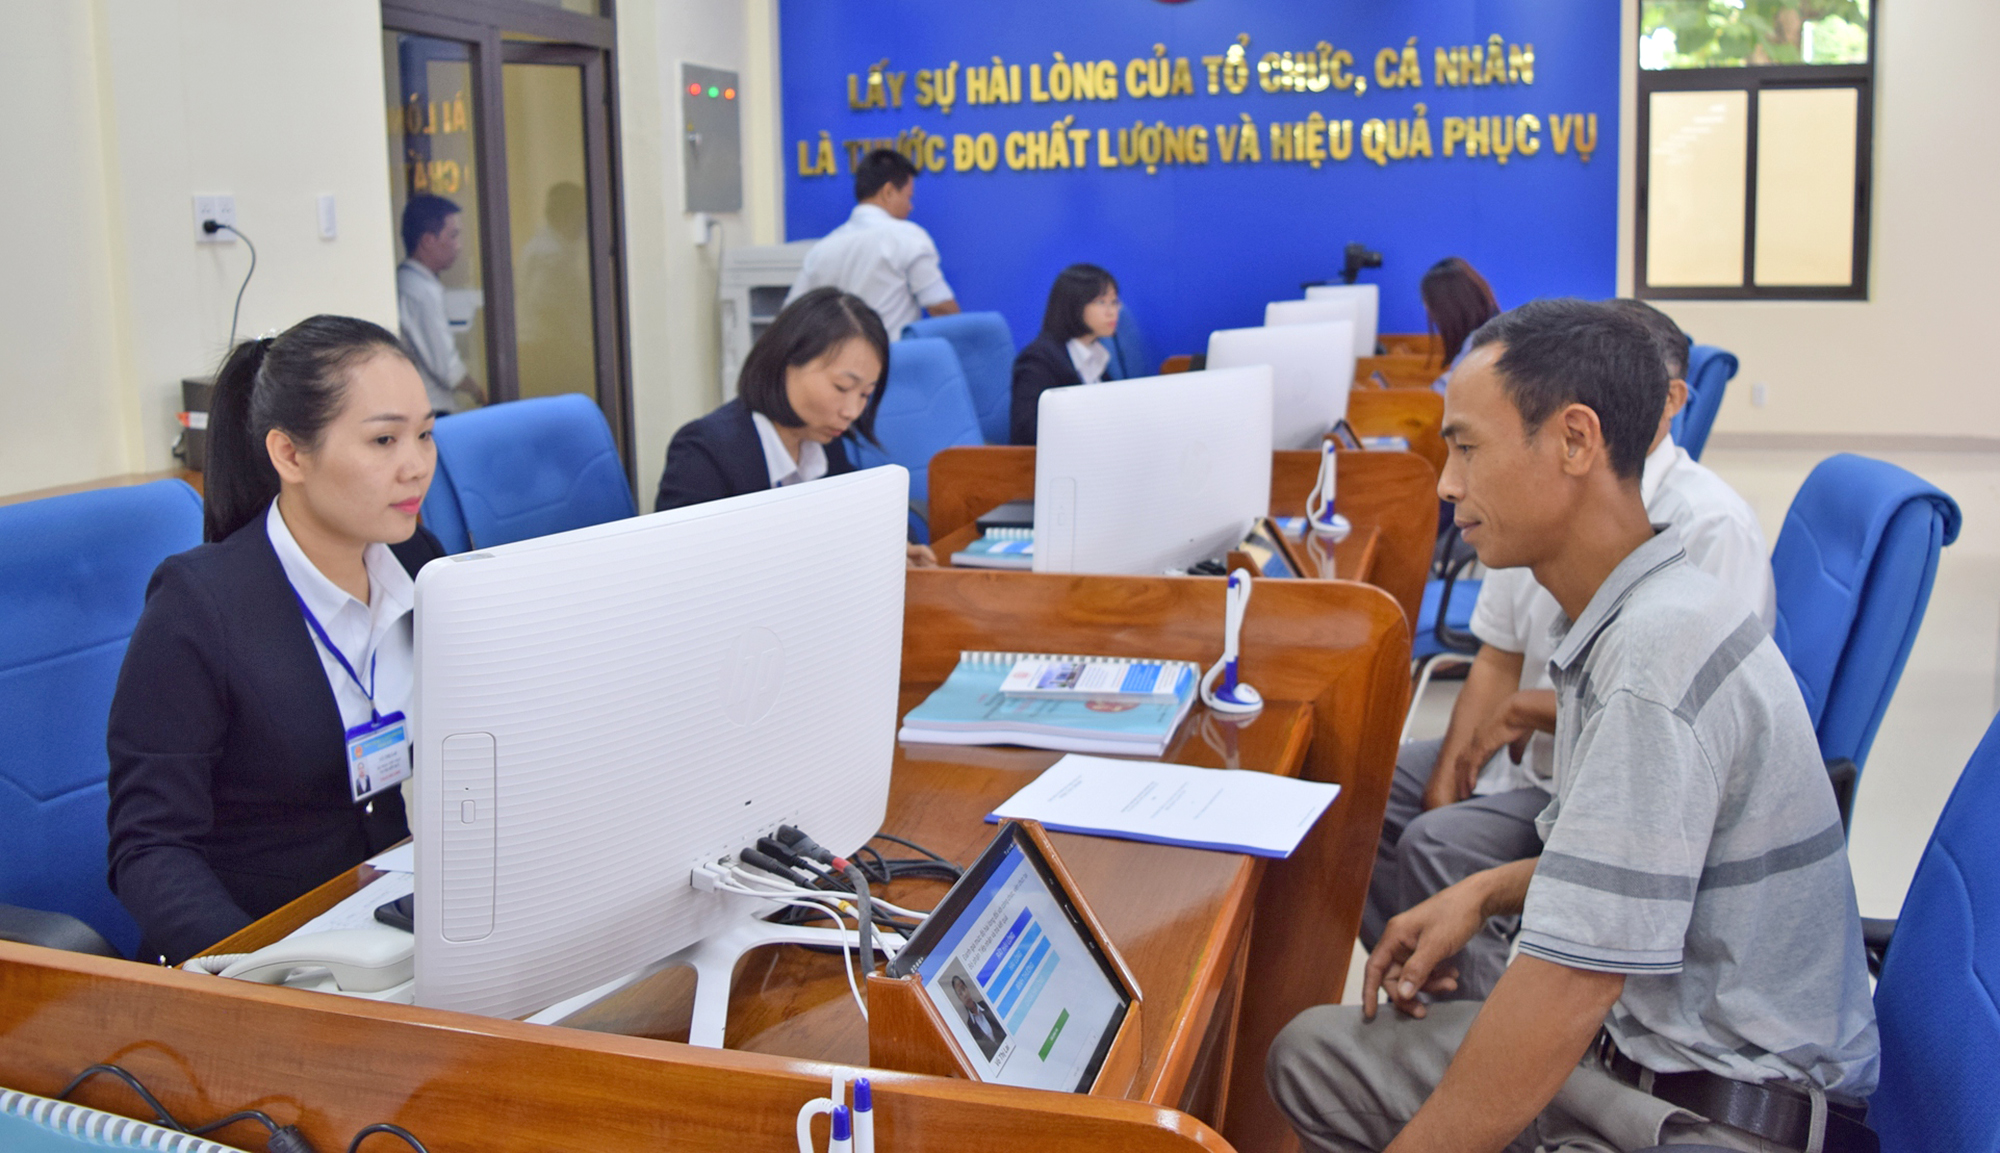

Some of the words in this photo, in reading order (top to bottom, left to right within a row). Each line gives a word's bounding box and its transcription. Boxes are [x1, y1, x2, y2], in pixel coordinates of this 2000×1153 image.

[847, 58, 906, 109] LẤY
[915, 61, 959, 114] SỰ
[966, 56, 1021, 104] HÀI
[1030, 51, 1118, 102] LÒNG
[1125, 43, 1194, 98] CỦA
[1202, 33, 1250, 94] TỔ
[1258, 41, 1367, 96] CHỨC,
[1375, 37, 1422, 88] CÁ
[1434, 34, 1534, 86] NHÂN
[797, 131, 837, 176] LÀ
[953, 133, 998, 172] ĐO
[1005, 115, 1090, 170] CHẤT
[1098, 121, 1208, 174] LƯỢNG
[1215, 113, 1261, 163] VÀ
[1270, 111, 1353, 168] HIỆU
[1361, 103, 1433, 165] QUẢ
[1443, 114, 1541, 164] PHỤC
[1549, 113, 1597, 162] VỤ
